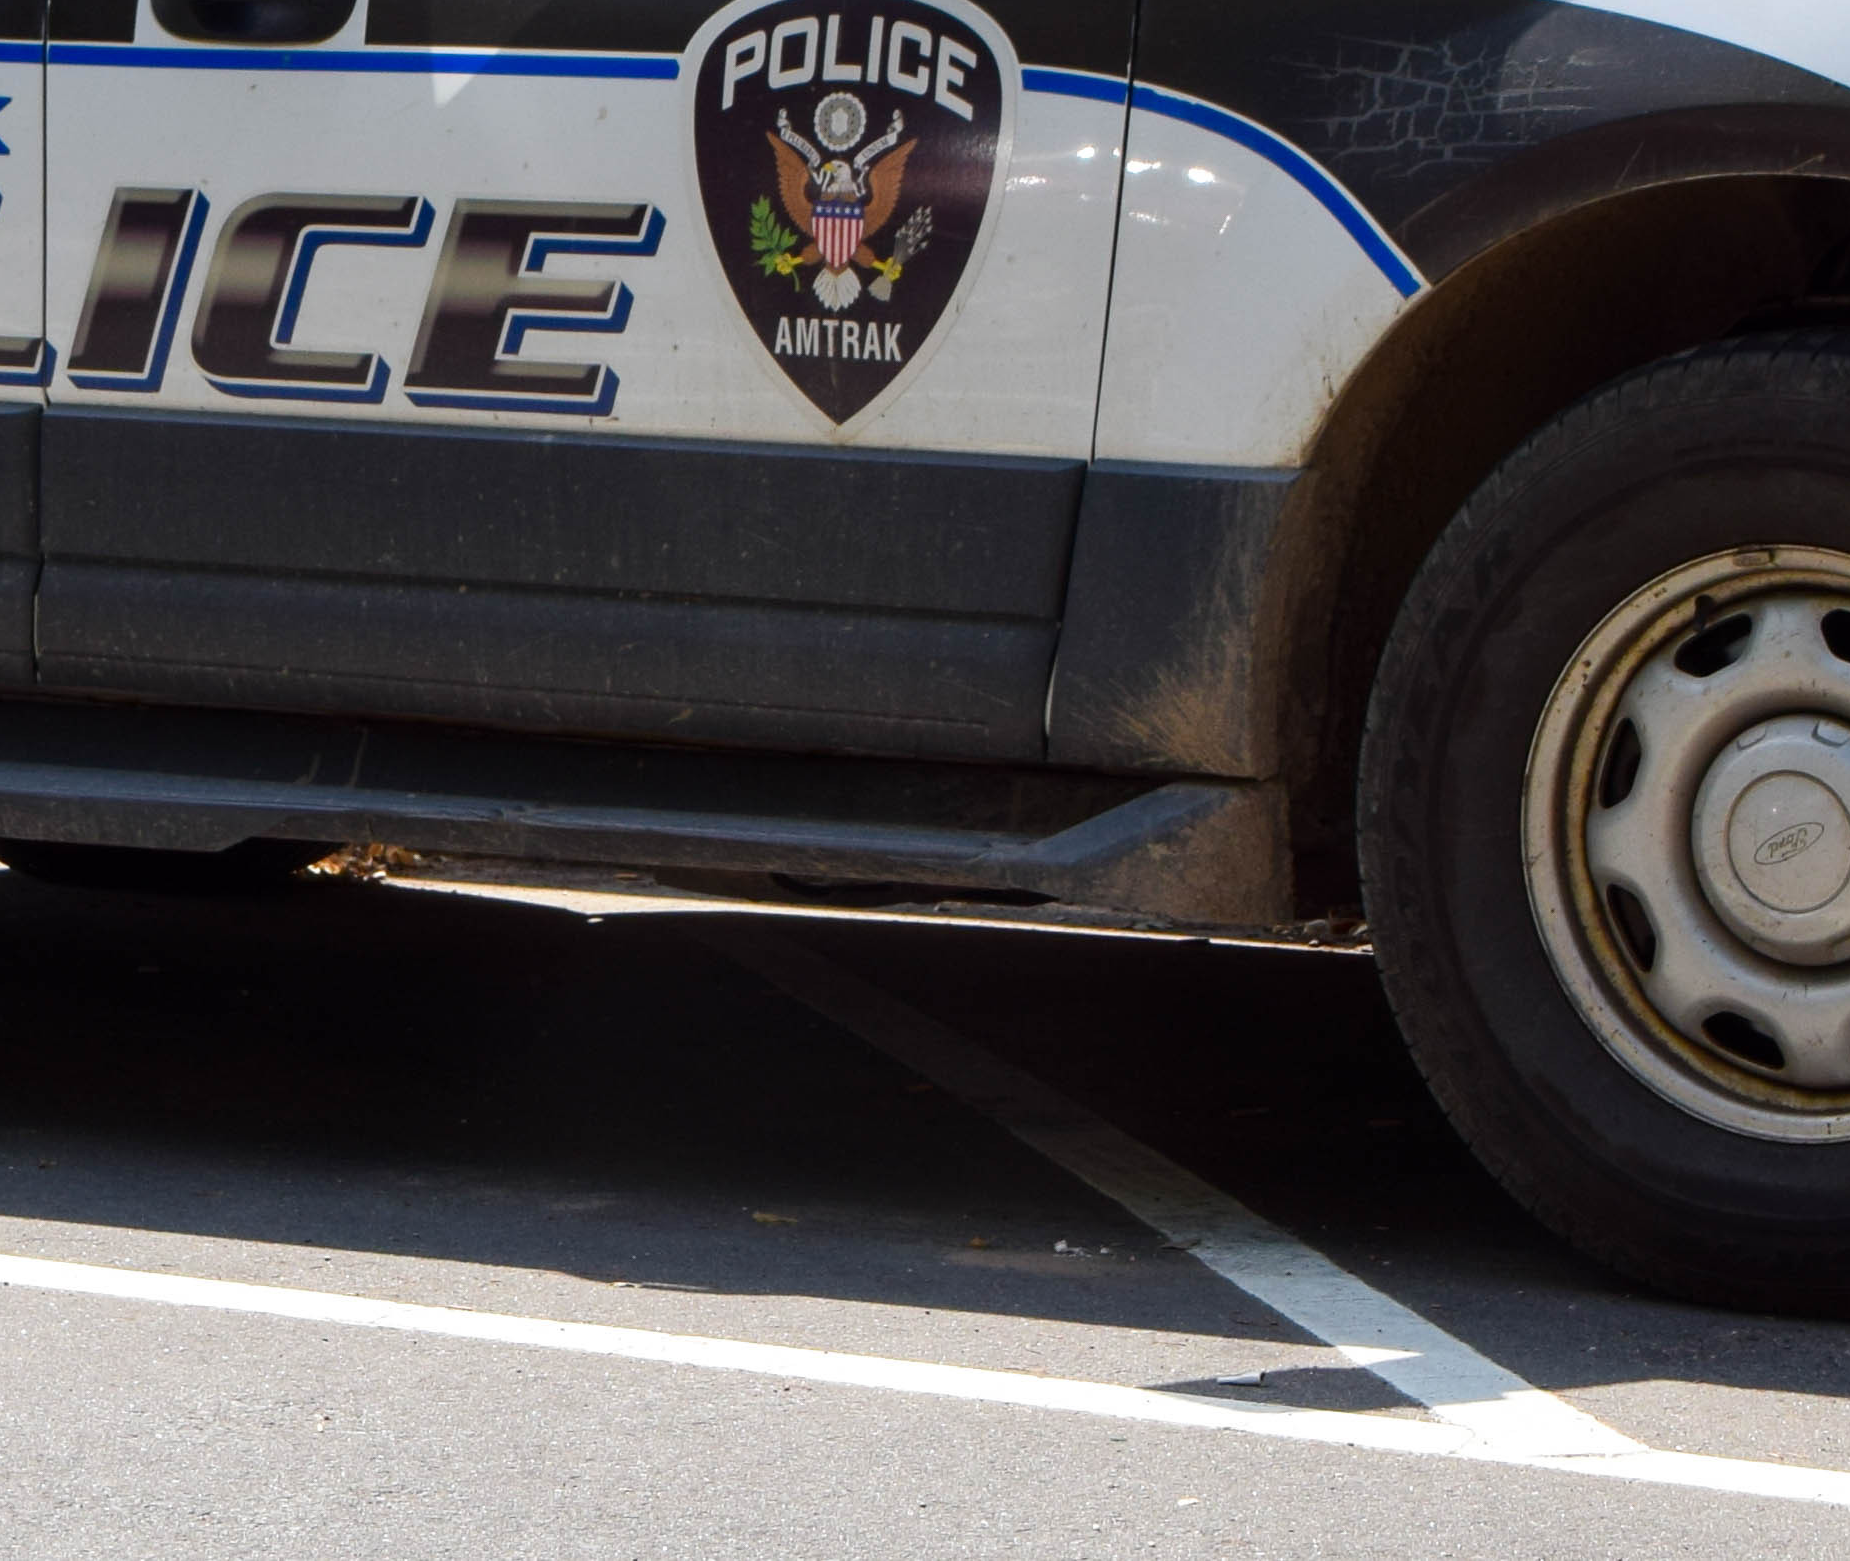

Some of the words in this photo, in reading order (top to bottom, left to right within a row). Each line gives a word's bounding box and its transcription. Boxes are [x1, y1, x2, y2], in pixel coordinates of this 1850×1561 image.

[722, 14, 978, 122] POLICE
[774, 316, 902, 362] AMTRAK
[1766, 826, 1808, 859] Ford
